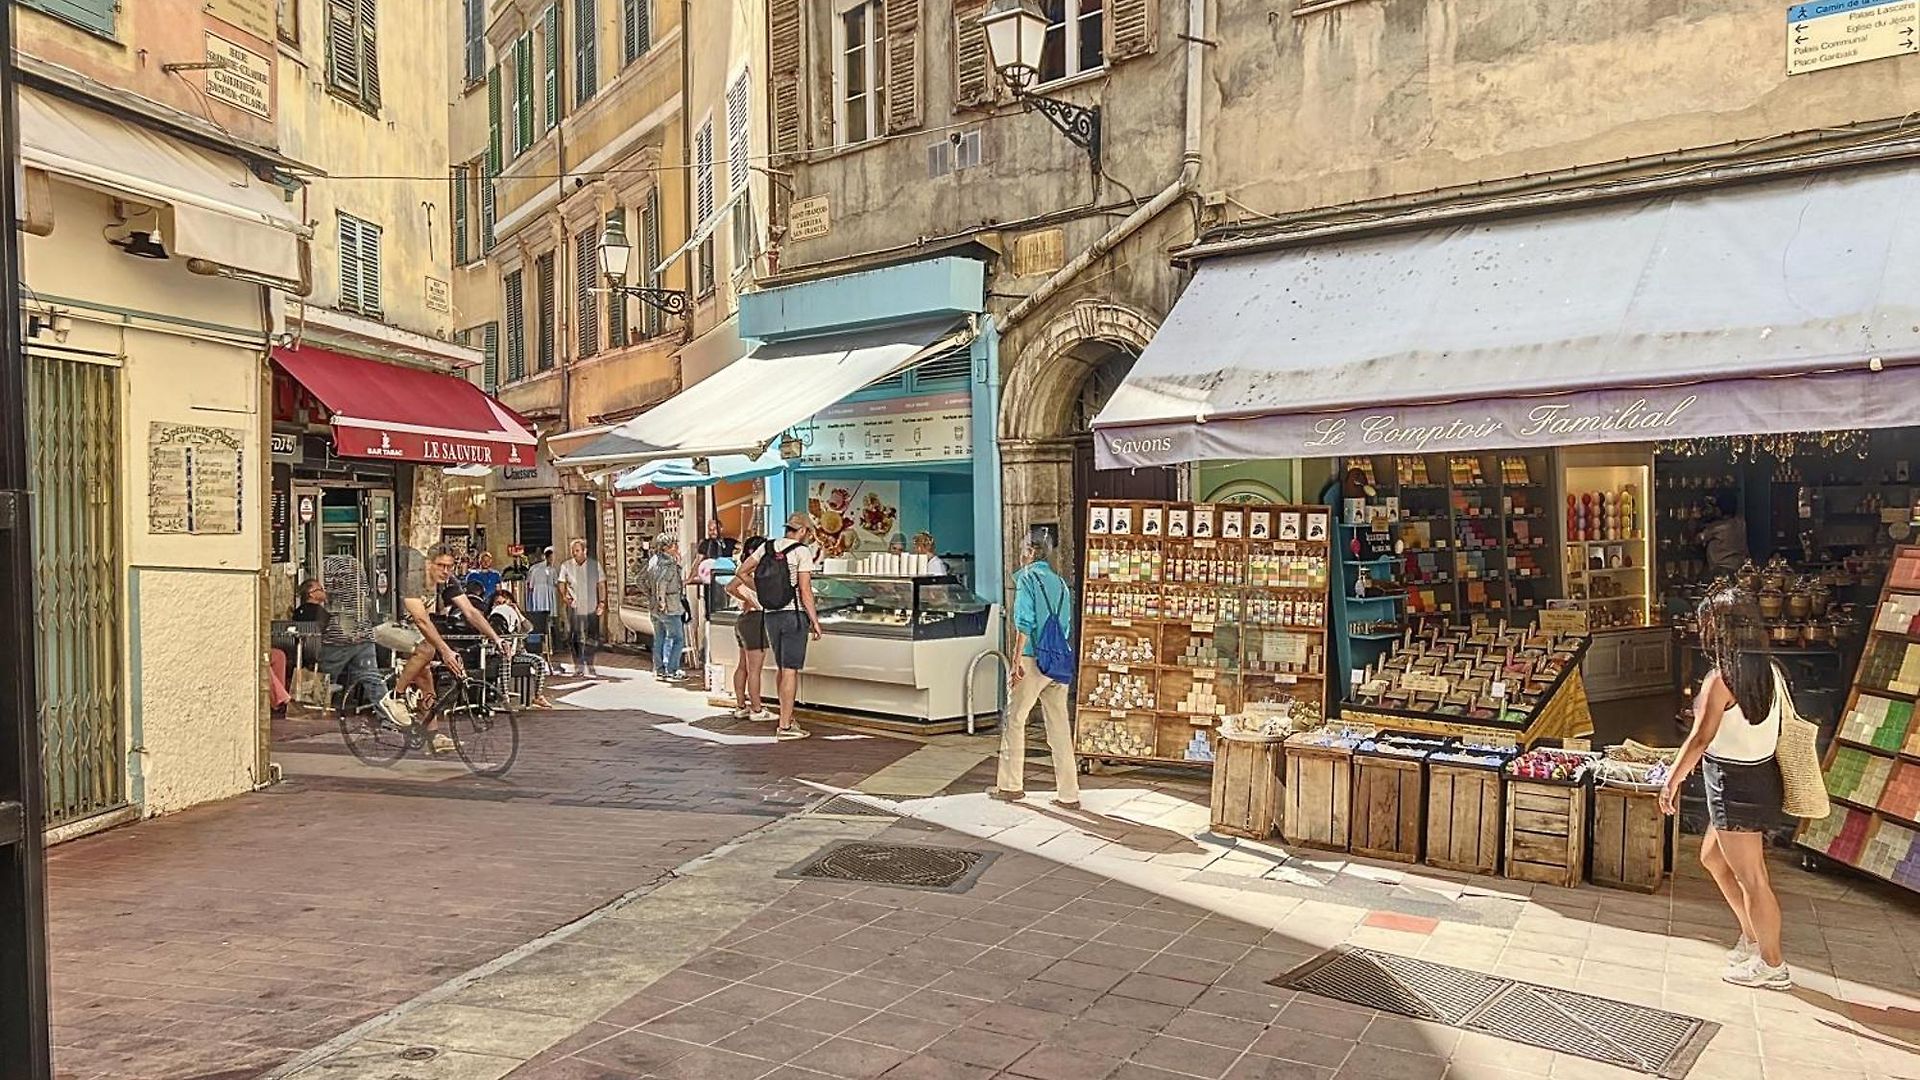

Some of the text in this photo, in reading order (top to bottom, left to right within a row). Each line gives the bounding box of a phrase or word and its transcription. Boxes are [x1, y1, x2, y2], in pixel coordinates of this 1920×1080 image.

[1815, 2, 1845, 14] Camin
[1849, 9, 1875, 20] Palais
[1875, 18, 1886, 28] du
[1793, 34, 1868, 55] Palais Communal
[1793, 49, 1859, 67] Place Garibaldi
[1304, 395, 1698, 450] Le Comptoir Familial
[366, 447, 404, 456] BAR TABAC
[423, 440, 493, 463] LE SAUVEUR
[1110, 435, 1172, 456] Savons
